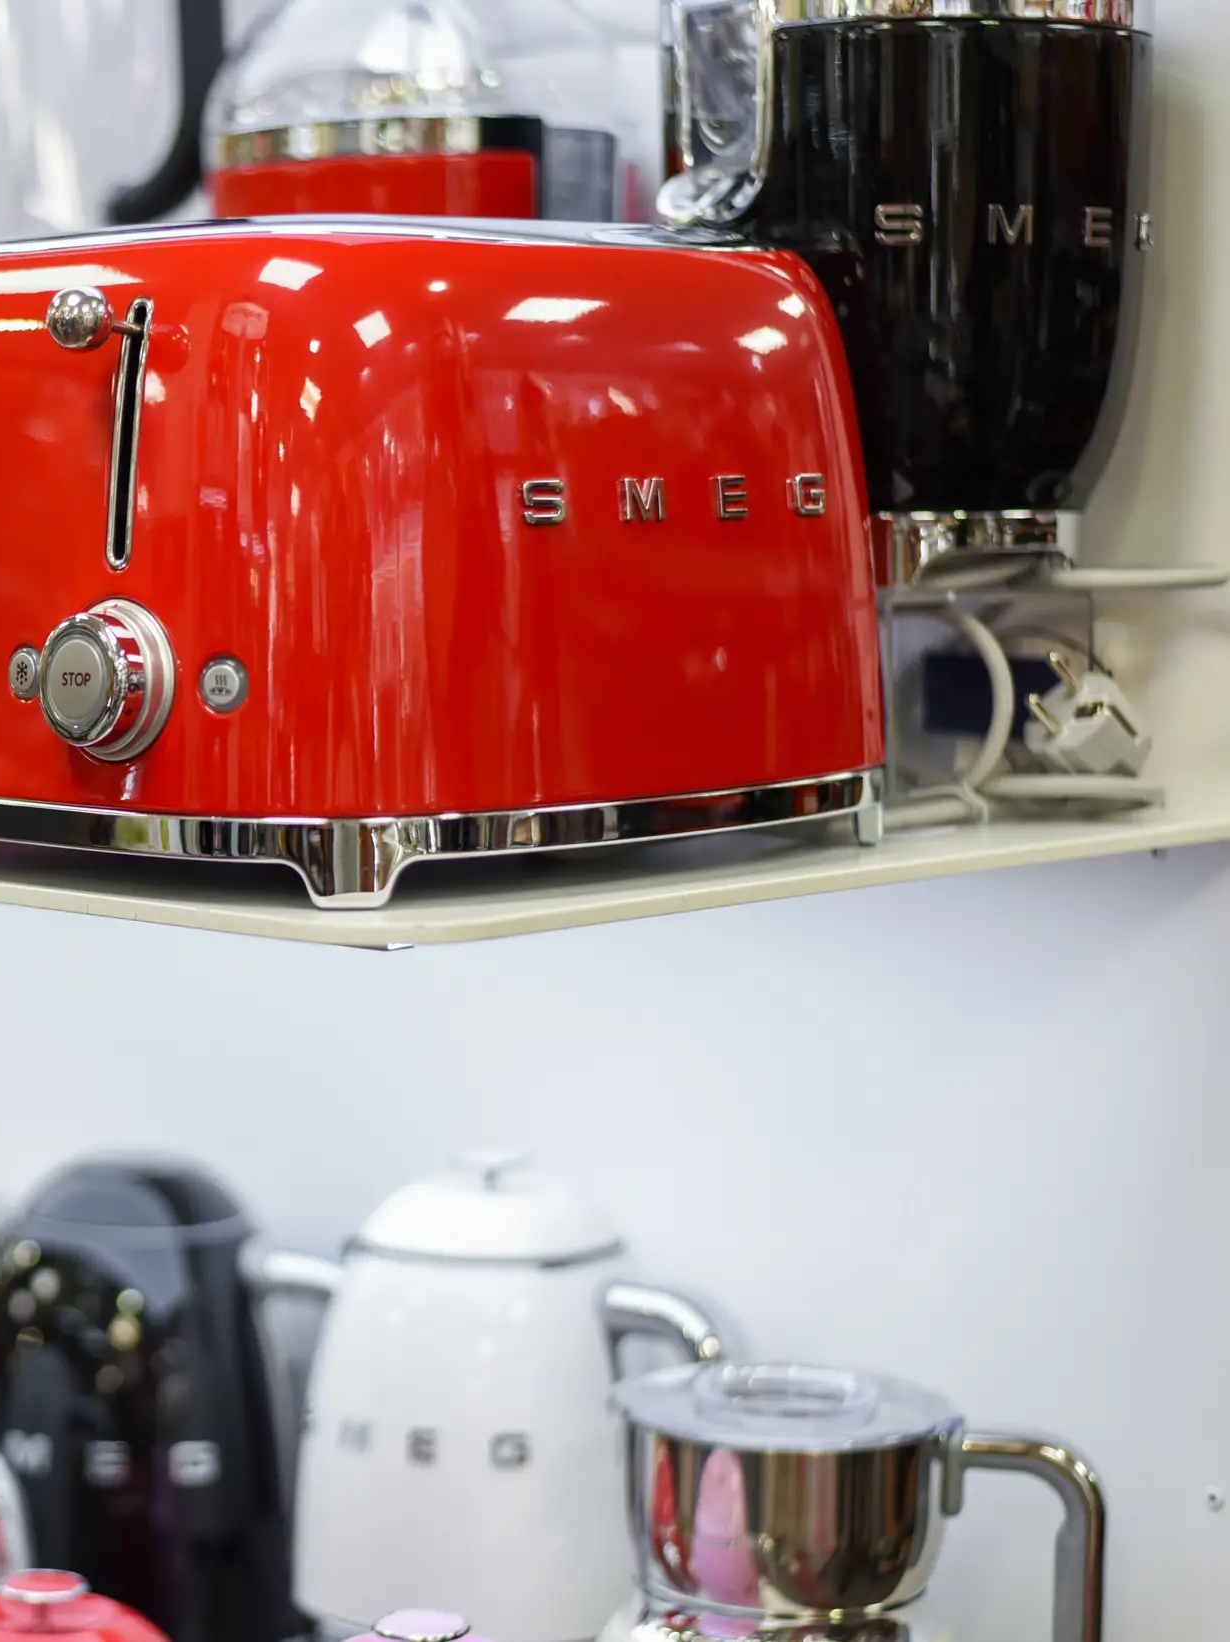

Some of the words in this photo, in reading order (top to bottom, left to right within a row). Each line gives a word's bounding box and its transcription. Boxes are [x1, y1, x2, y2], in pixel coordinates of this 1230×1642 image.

[520, 473, 826, 524] SMEG
[61, 671, 91, 687] STOP
[1, 1429, 221, 1487] MEG
[302, 1412, 534, 1472] MEG
